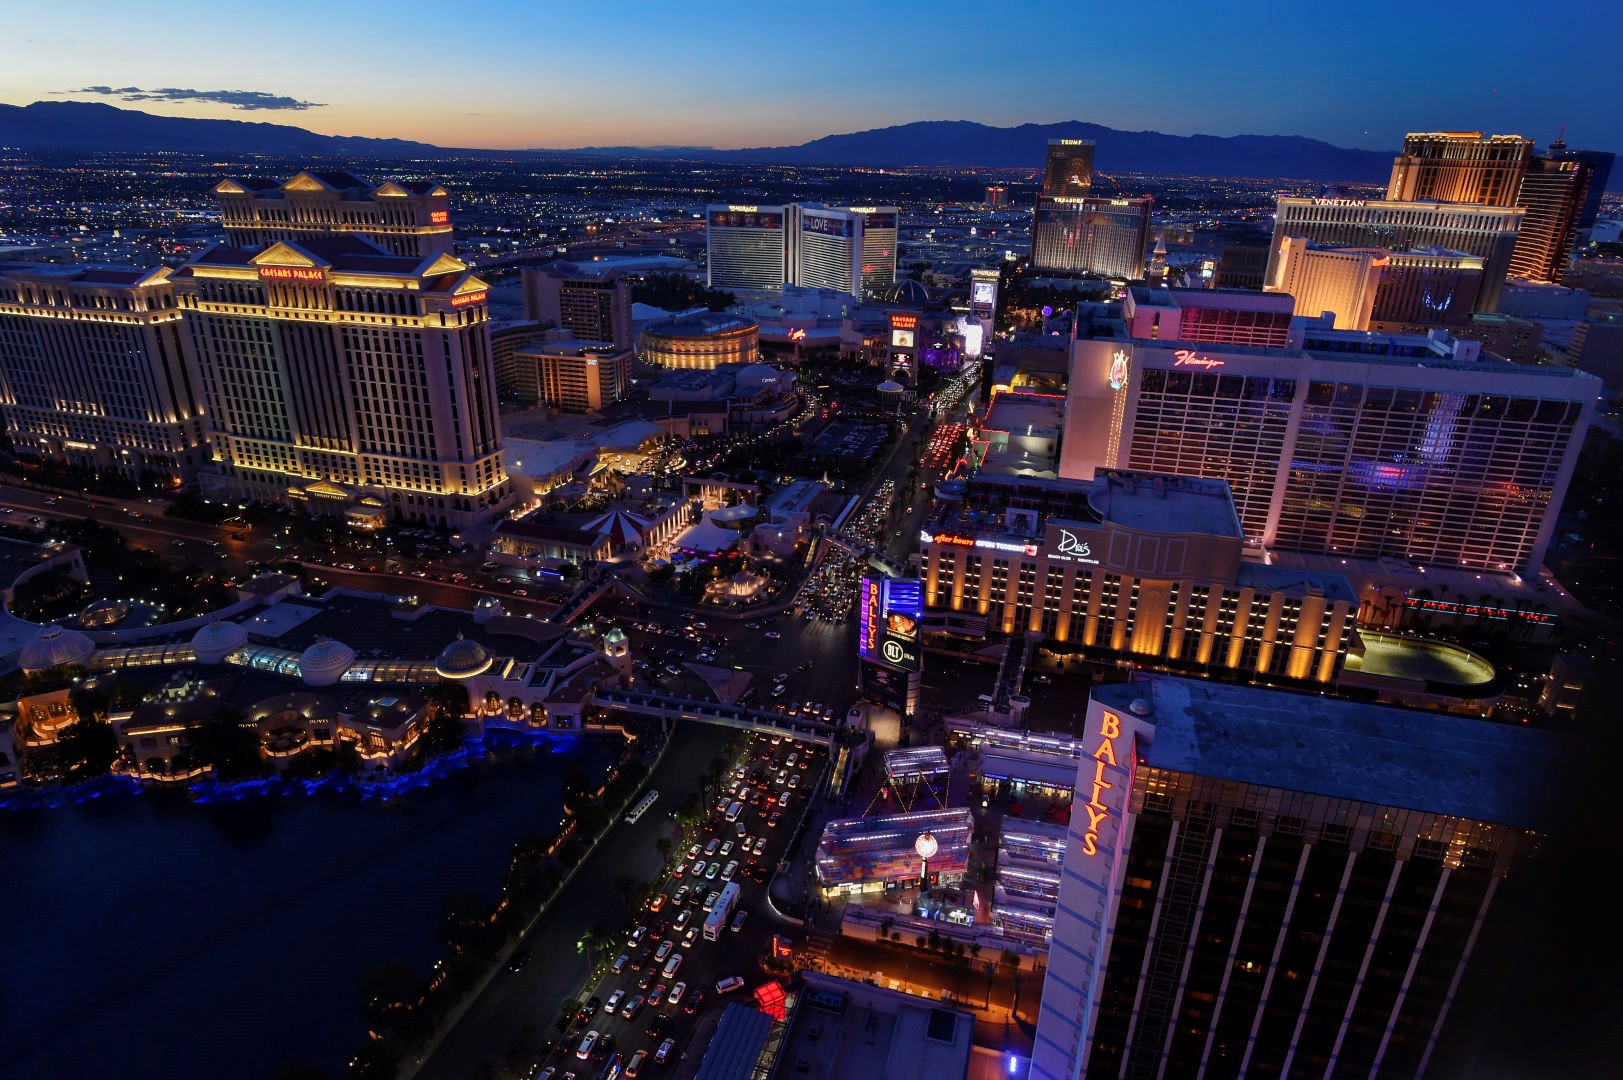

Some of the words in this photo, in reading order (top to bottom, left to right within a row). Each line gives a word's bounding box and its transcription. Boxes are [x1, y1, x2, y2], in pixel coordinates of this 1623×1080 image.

[1314, 198, 1365, 207] VENETIAN
[811, 218, 828, 231] LOVE
[260, 268, 292, 278] CAESARS
[293, 270, 323, 280] PALACE
[451, 296, 470, 306] CAESARS
[470, 292, 486, 301] PALACE
[1174, 350, 1225, 370] Flamingo
[934, 534, 952, 543] after
[952, 536, 975, 546] hours
[887, 644, 900, 659] BLT
